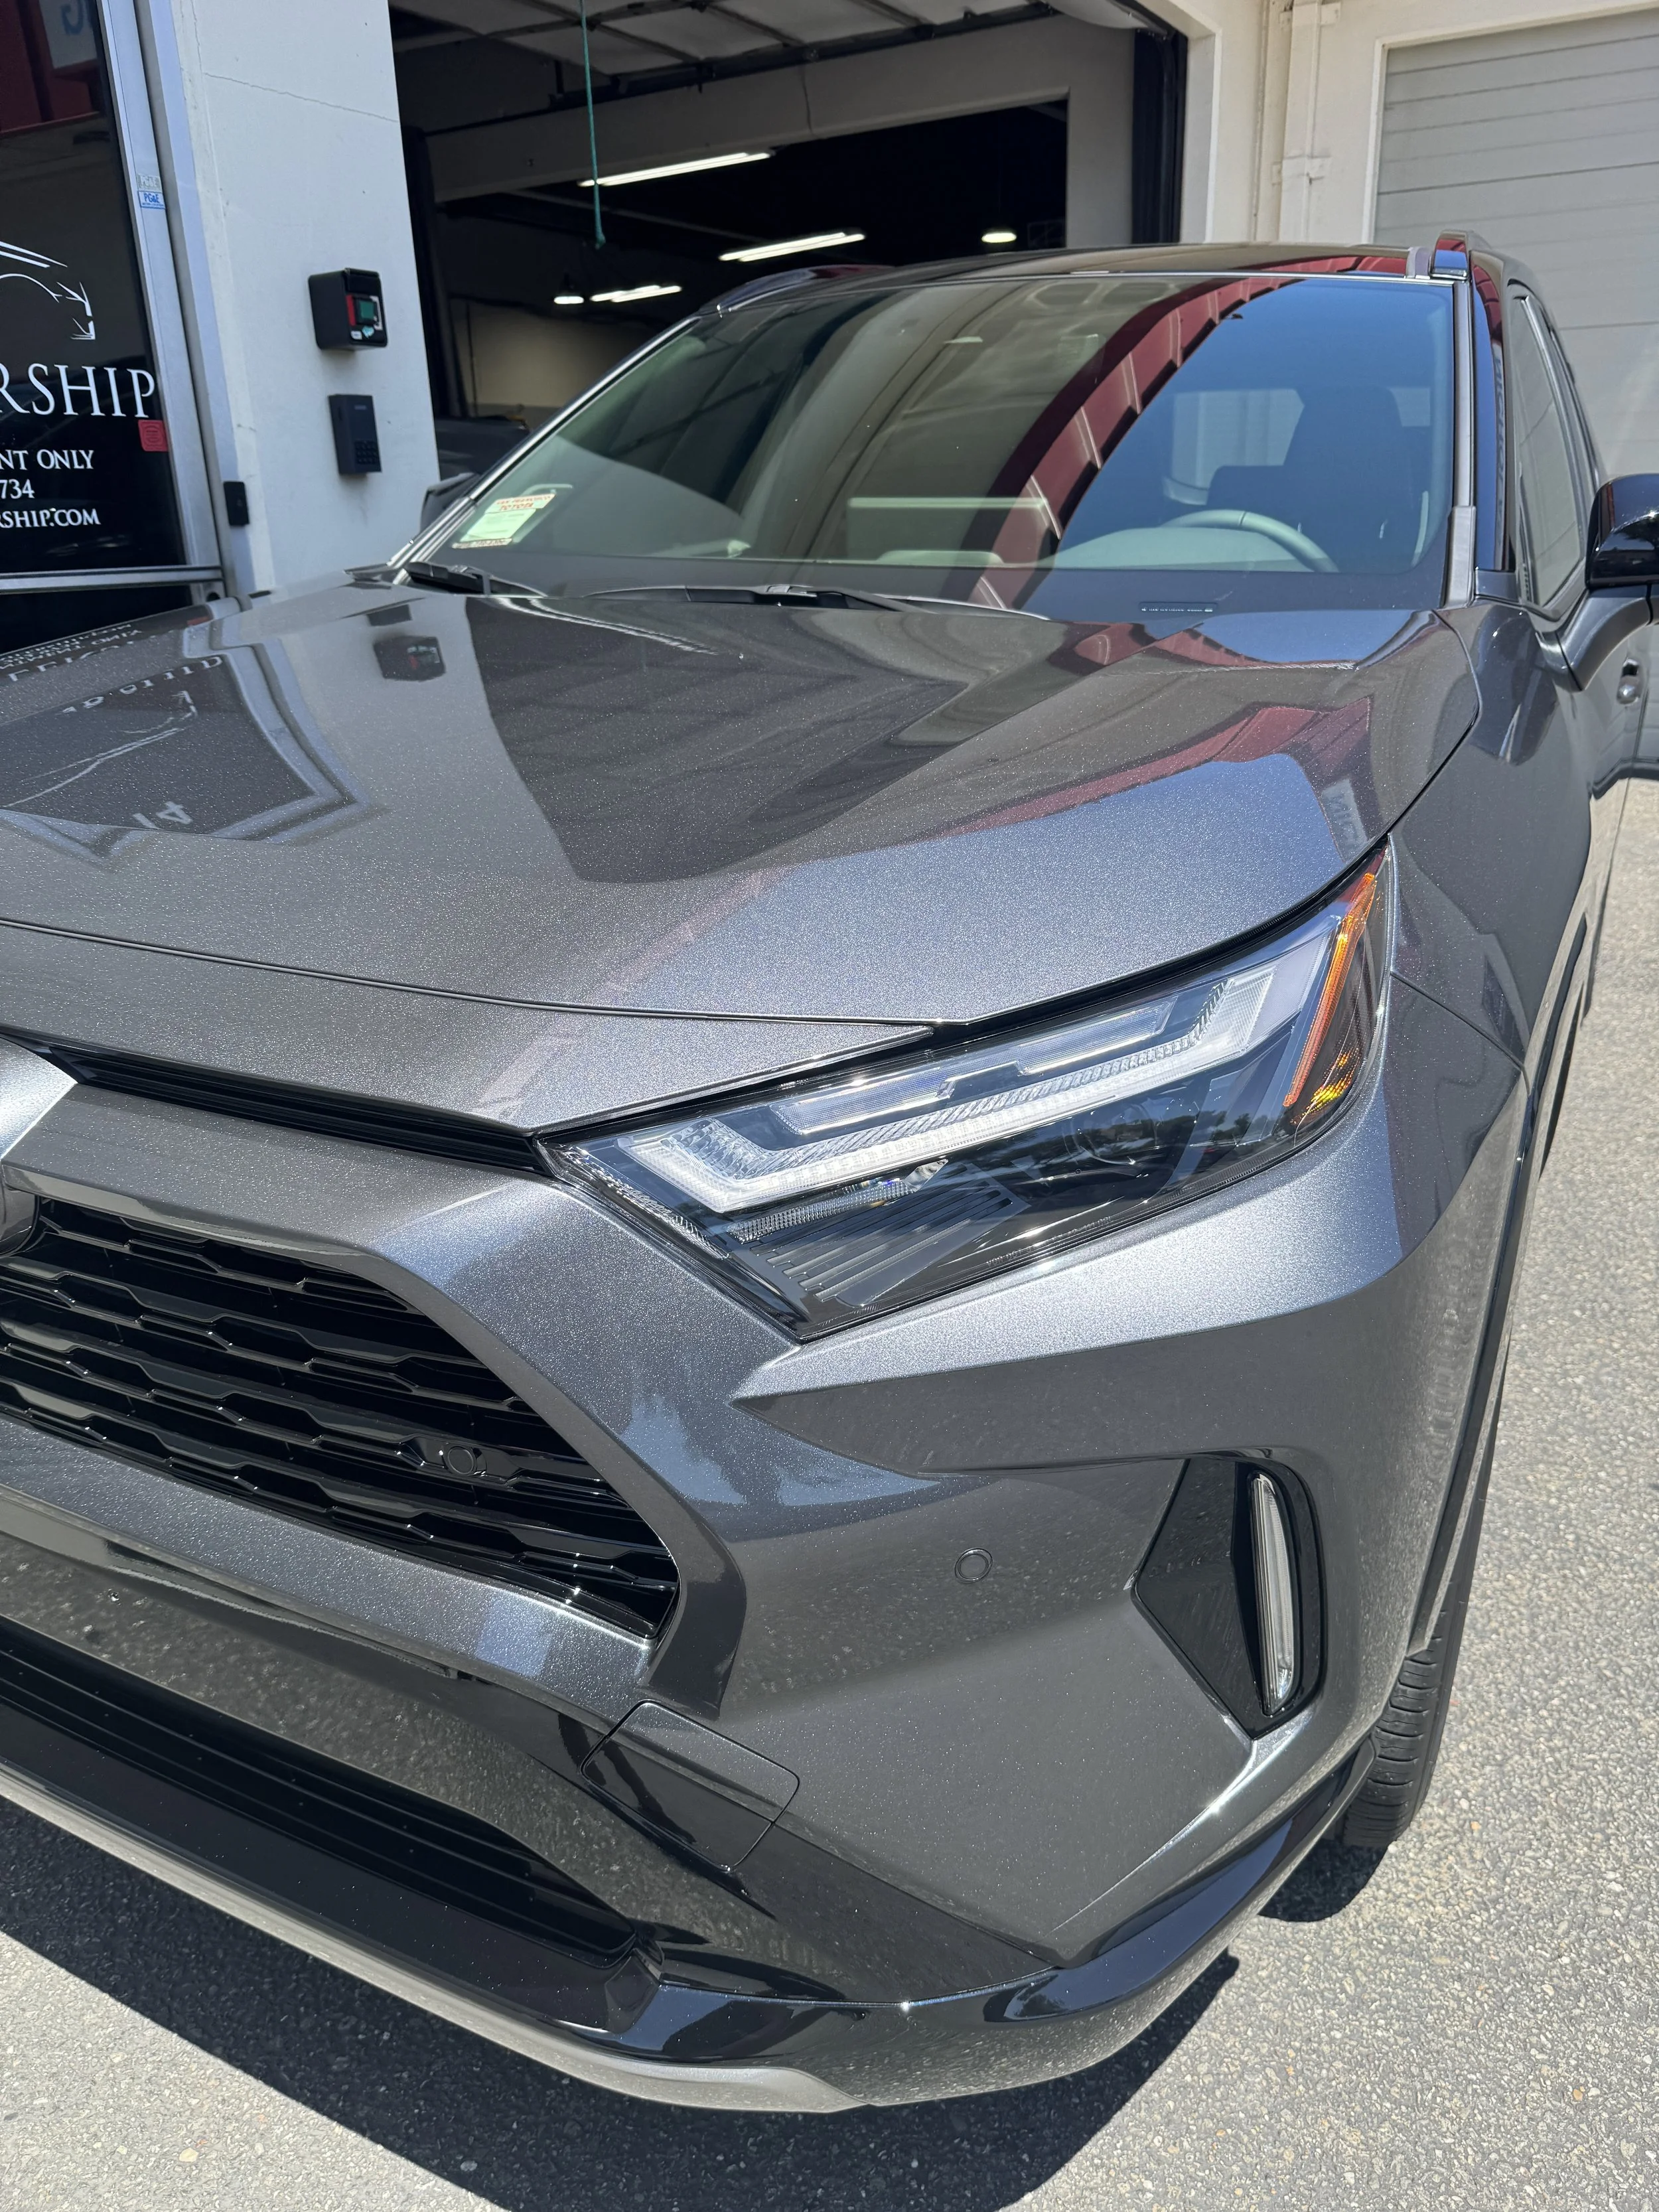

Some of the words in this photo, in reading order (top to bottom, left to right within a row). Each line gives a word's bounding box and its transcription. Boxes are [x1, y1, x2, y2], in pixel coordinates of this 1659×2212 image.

[36, 449, 94, 470] ONLY
[0, 479, 35, 499] 734
[0, 508, 102, 528] SHIP.COM
